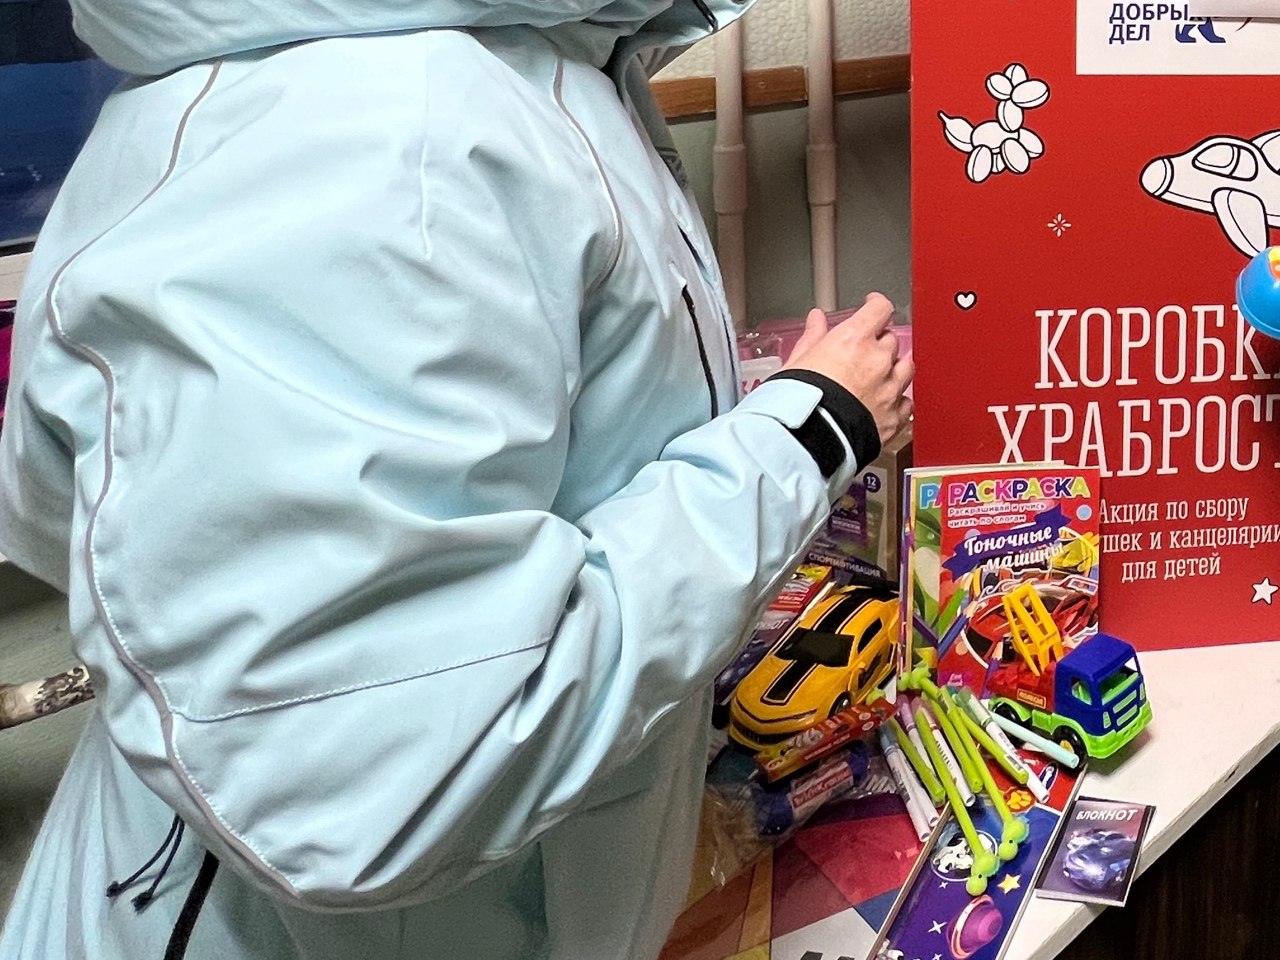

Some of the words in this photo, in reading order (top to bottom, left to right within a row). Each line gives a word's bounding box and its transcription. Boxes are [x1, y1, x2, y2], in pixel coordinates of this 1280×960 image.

[1108, 3, 1204, 24] ДОБРЫ
[1108, 24, 1150, 45] ДЕЛ
[866, 476, 877, 487] 12
[948, 476, 1091, 507] РАСКРАСКА
[949, 504, 1010, 516] Раскрашивай
[1020, 503, 1046, 512] учись
[1099, 498, 1160, 524] Акция
[1165, 501, 1189, 521] по
[1194, 497, 1250, 522] сбору
[949, 518, 978, 528] читать
[994, 515, 1026, 524] слогам
[964, 527, 1053, 556] Гоночные
[1149, 531, 1163, 550] и
[983, 541, 1065, 574] машины
[1121, 559, 1158, 584] для
[1163, 551, 1221, 581] детей
[1076, 808, 1139, 822] БЛОКНОТ
